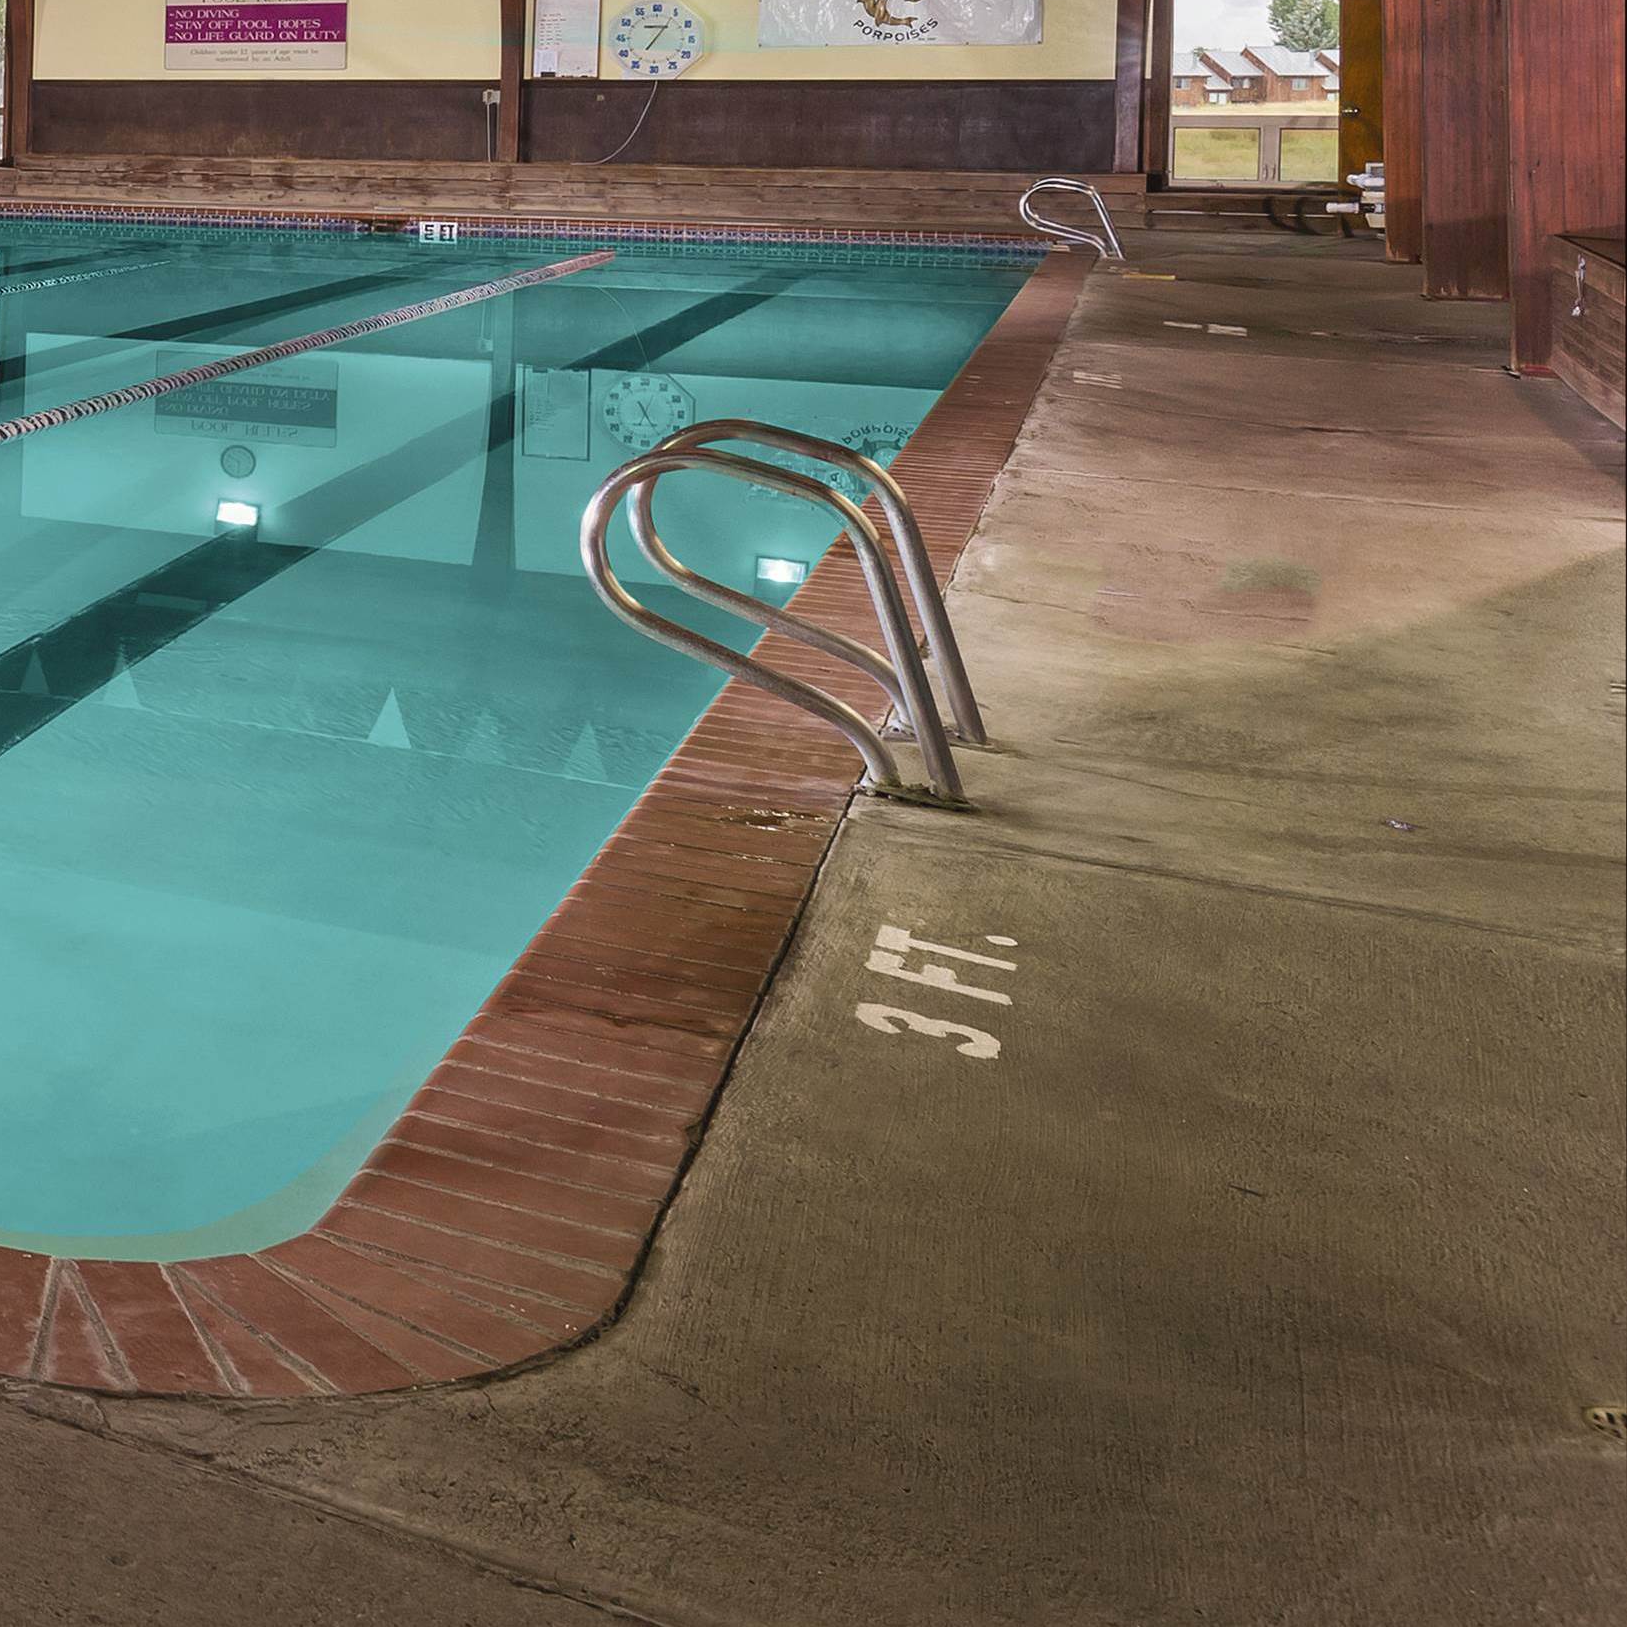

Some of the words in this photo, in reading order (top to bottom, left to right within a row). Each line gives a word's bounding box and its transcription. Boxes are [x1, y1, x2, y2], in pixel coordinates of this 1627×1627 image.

[197, 9, 240, 18] DIVING
[208, 20, 233, 30] OFF
[237, 19, 272, 29] POOL
[278, 18, 321, 29] ROPES
[853, 18, 939, 42] PORPOISES
[197, 31, 225, 41] LIFE
[229, 31, 274, 41] GUARD
[279, 30, 298, 40] ON
[304, 30, 340, 40] DUTY
[864, 924, 1019, 1006] FT.
[855, 1002, 1001, 1059] 3
